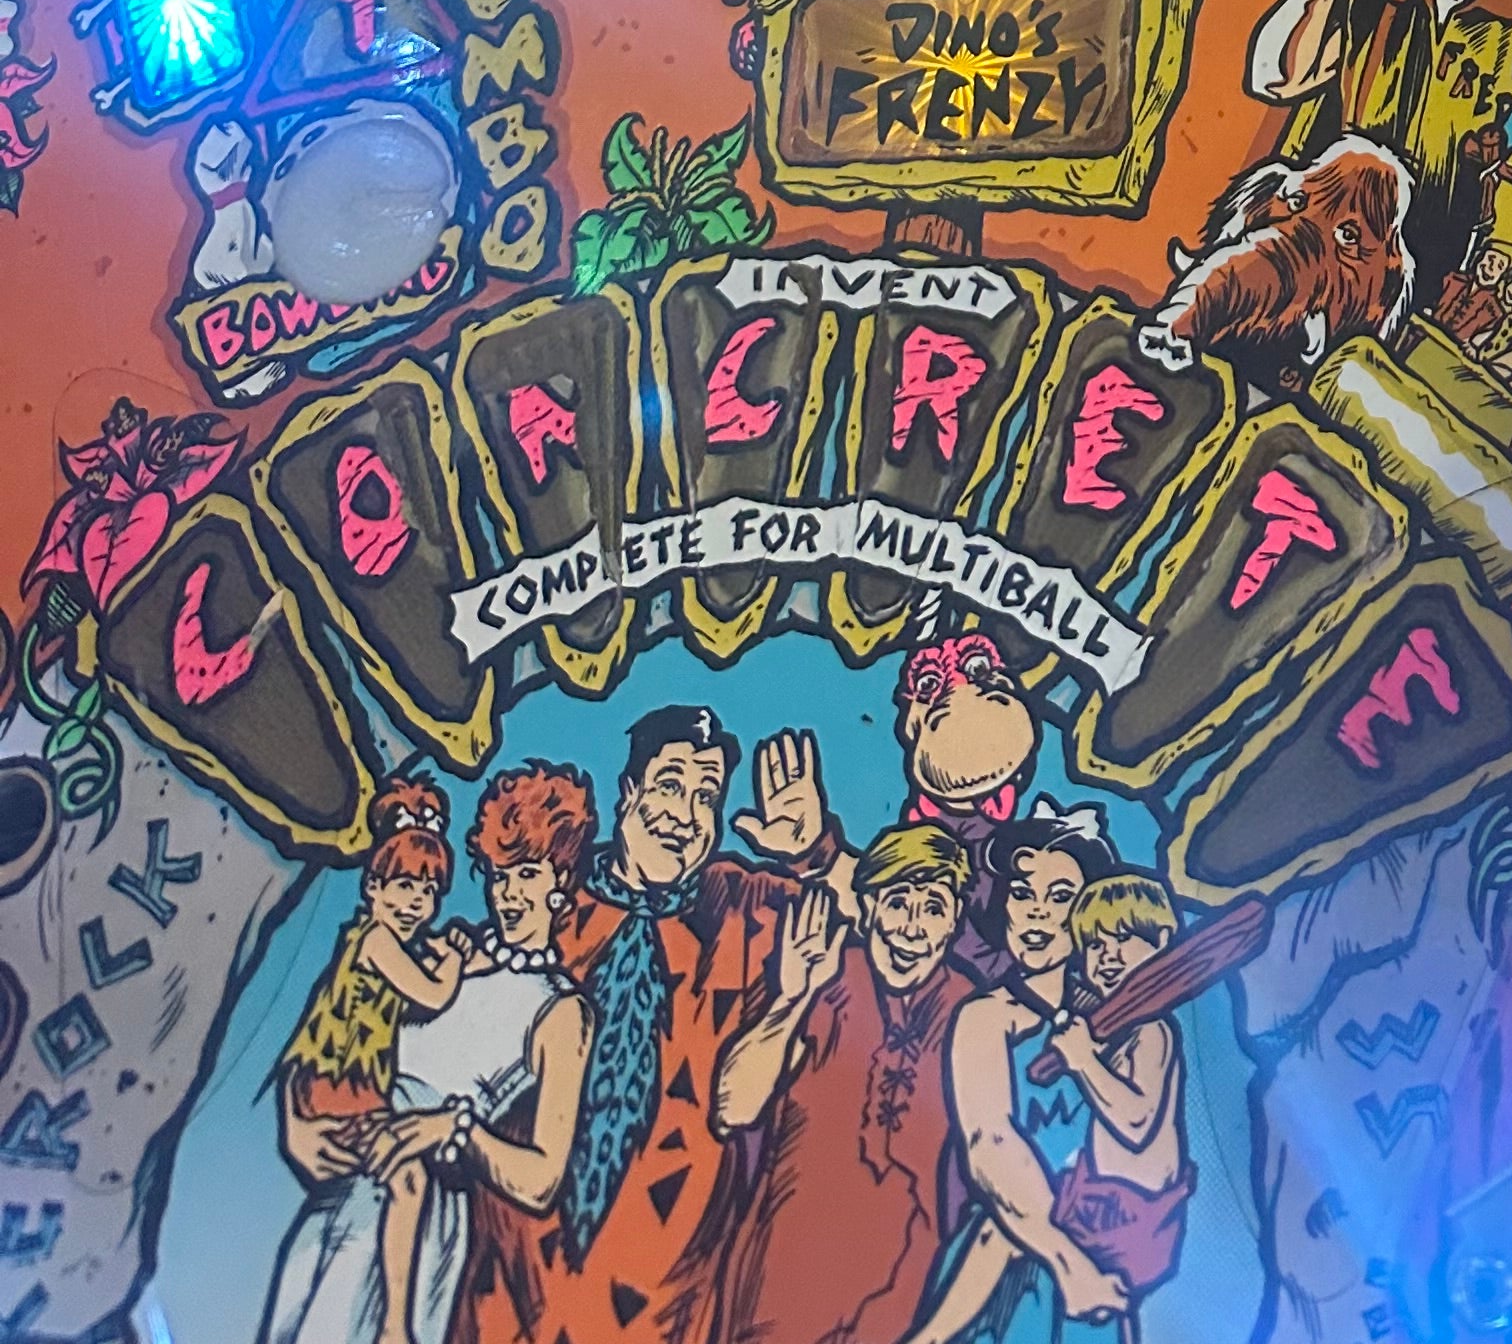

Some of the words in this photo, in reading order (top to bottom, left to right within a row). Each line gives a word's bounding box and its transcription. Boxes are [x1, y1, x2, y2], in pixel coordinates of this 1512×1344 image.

[826, 56, 1107, 147] FRENZY
[201, 258, 450, 367] BOWG
[751, 264, 998, 308] INVENT
[477, 515, 706, 629] COMPETE
[731, 510, 821, 555] FOR
[857, 515, 1112, 657] MULTIBALL
